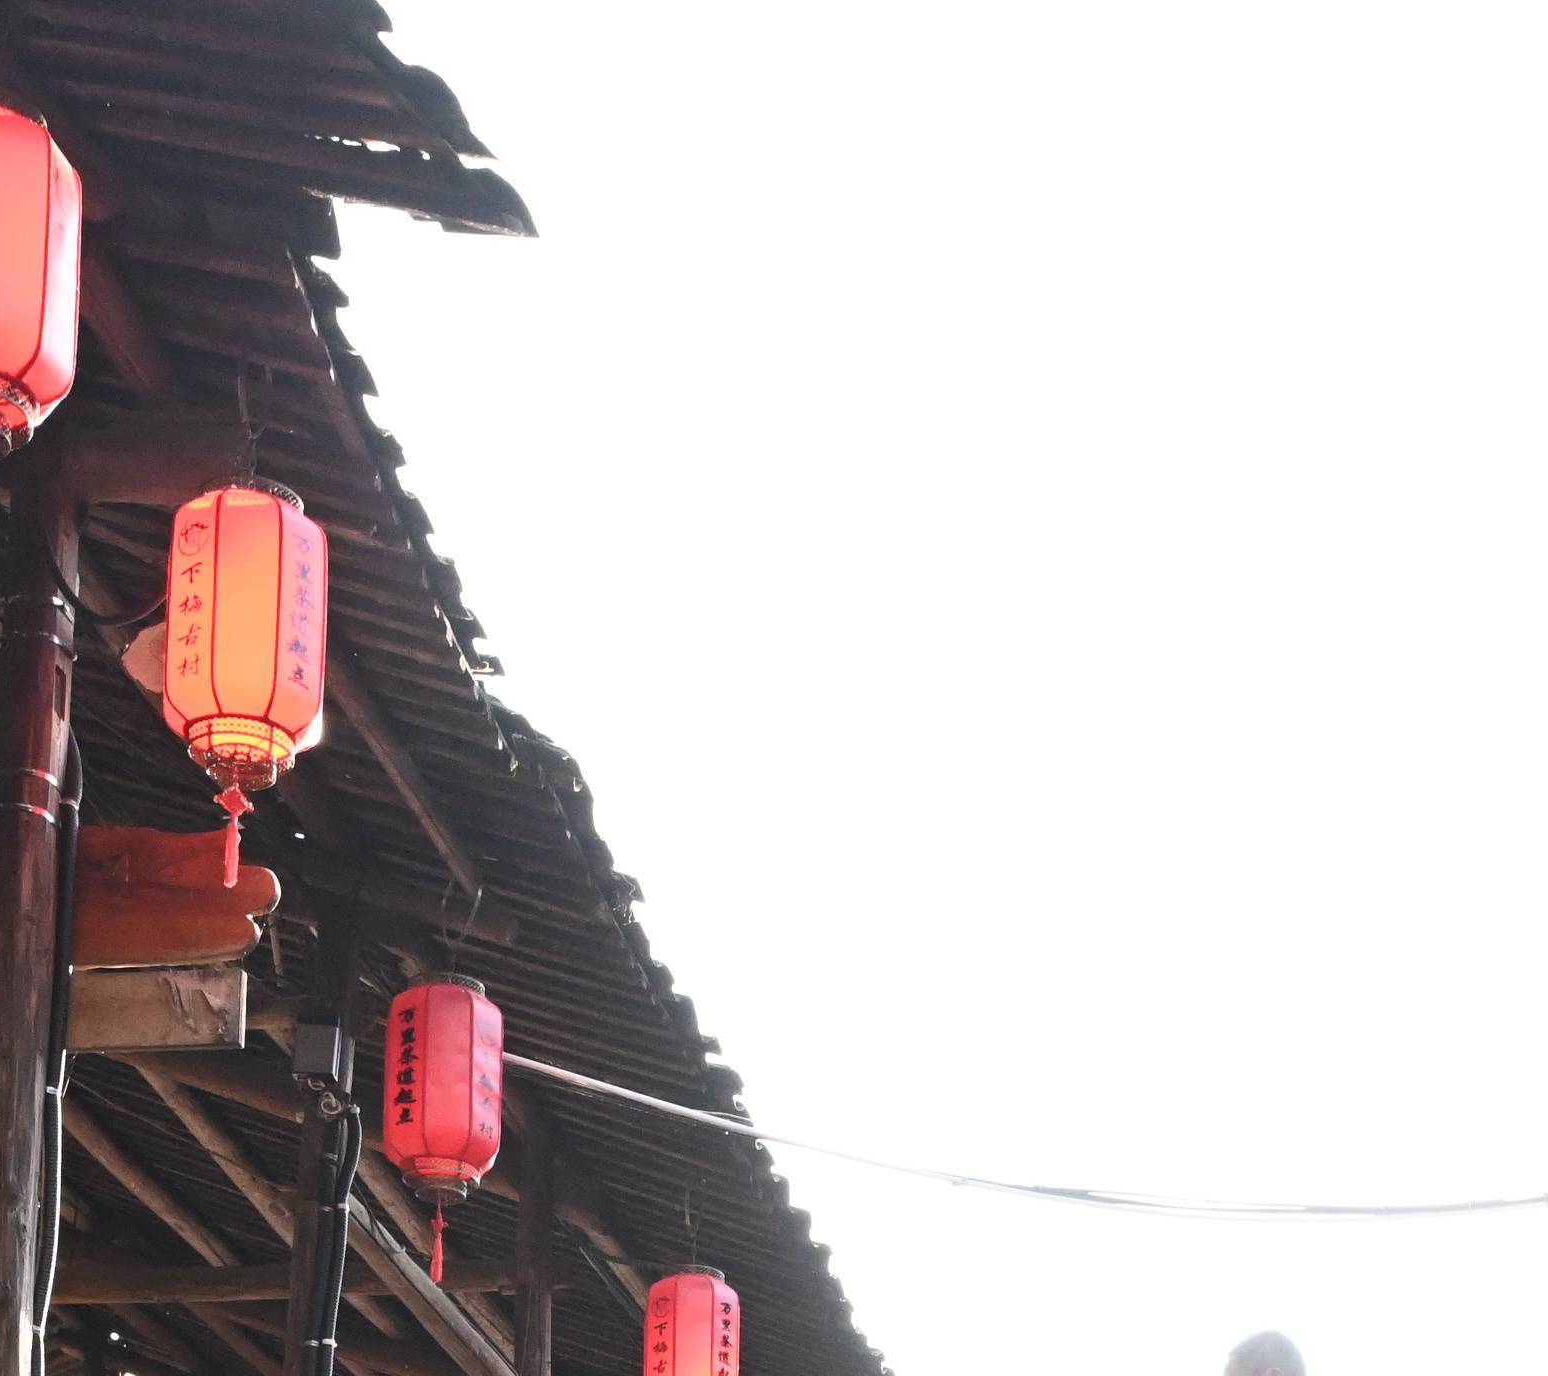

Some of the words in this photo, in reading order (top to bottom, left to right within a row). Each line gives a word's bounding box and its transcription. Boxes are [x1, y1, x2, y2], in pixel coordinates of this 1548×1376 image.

[178, 562, 203, 677] 下梅古村
[394, 1008, 418, 1126] 万里茶道起点
